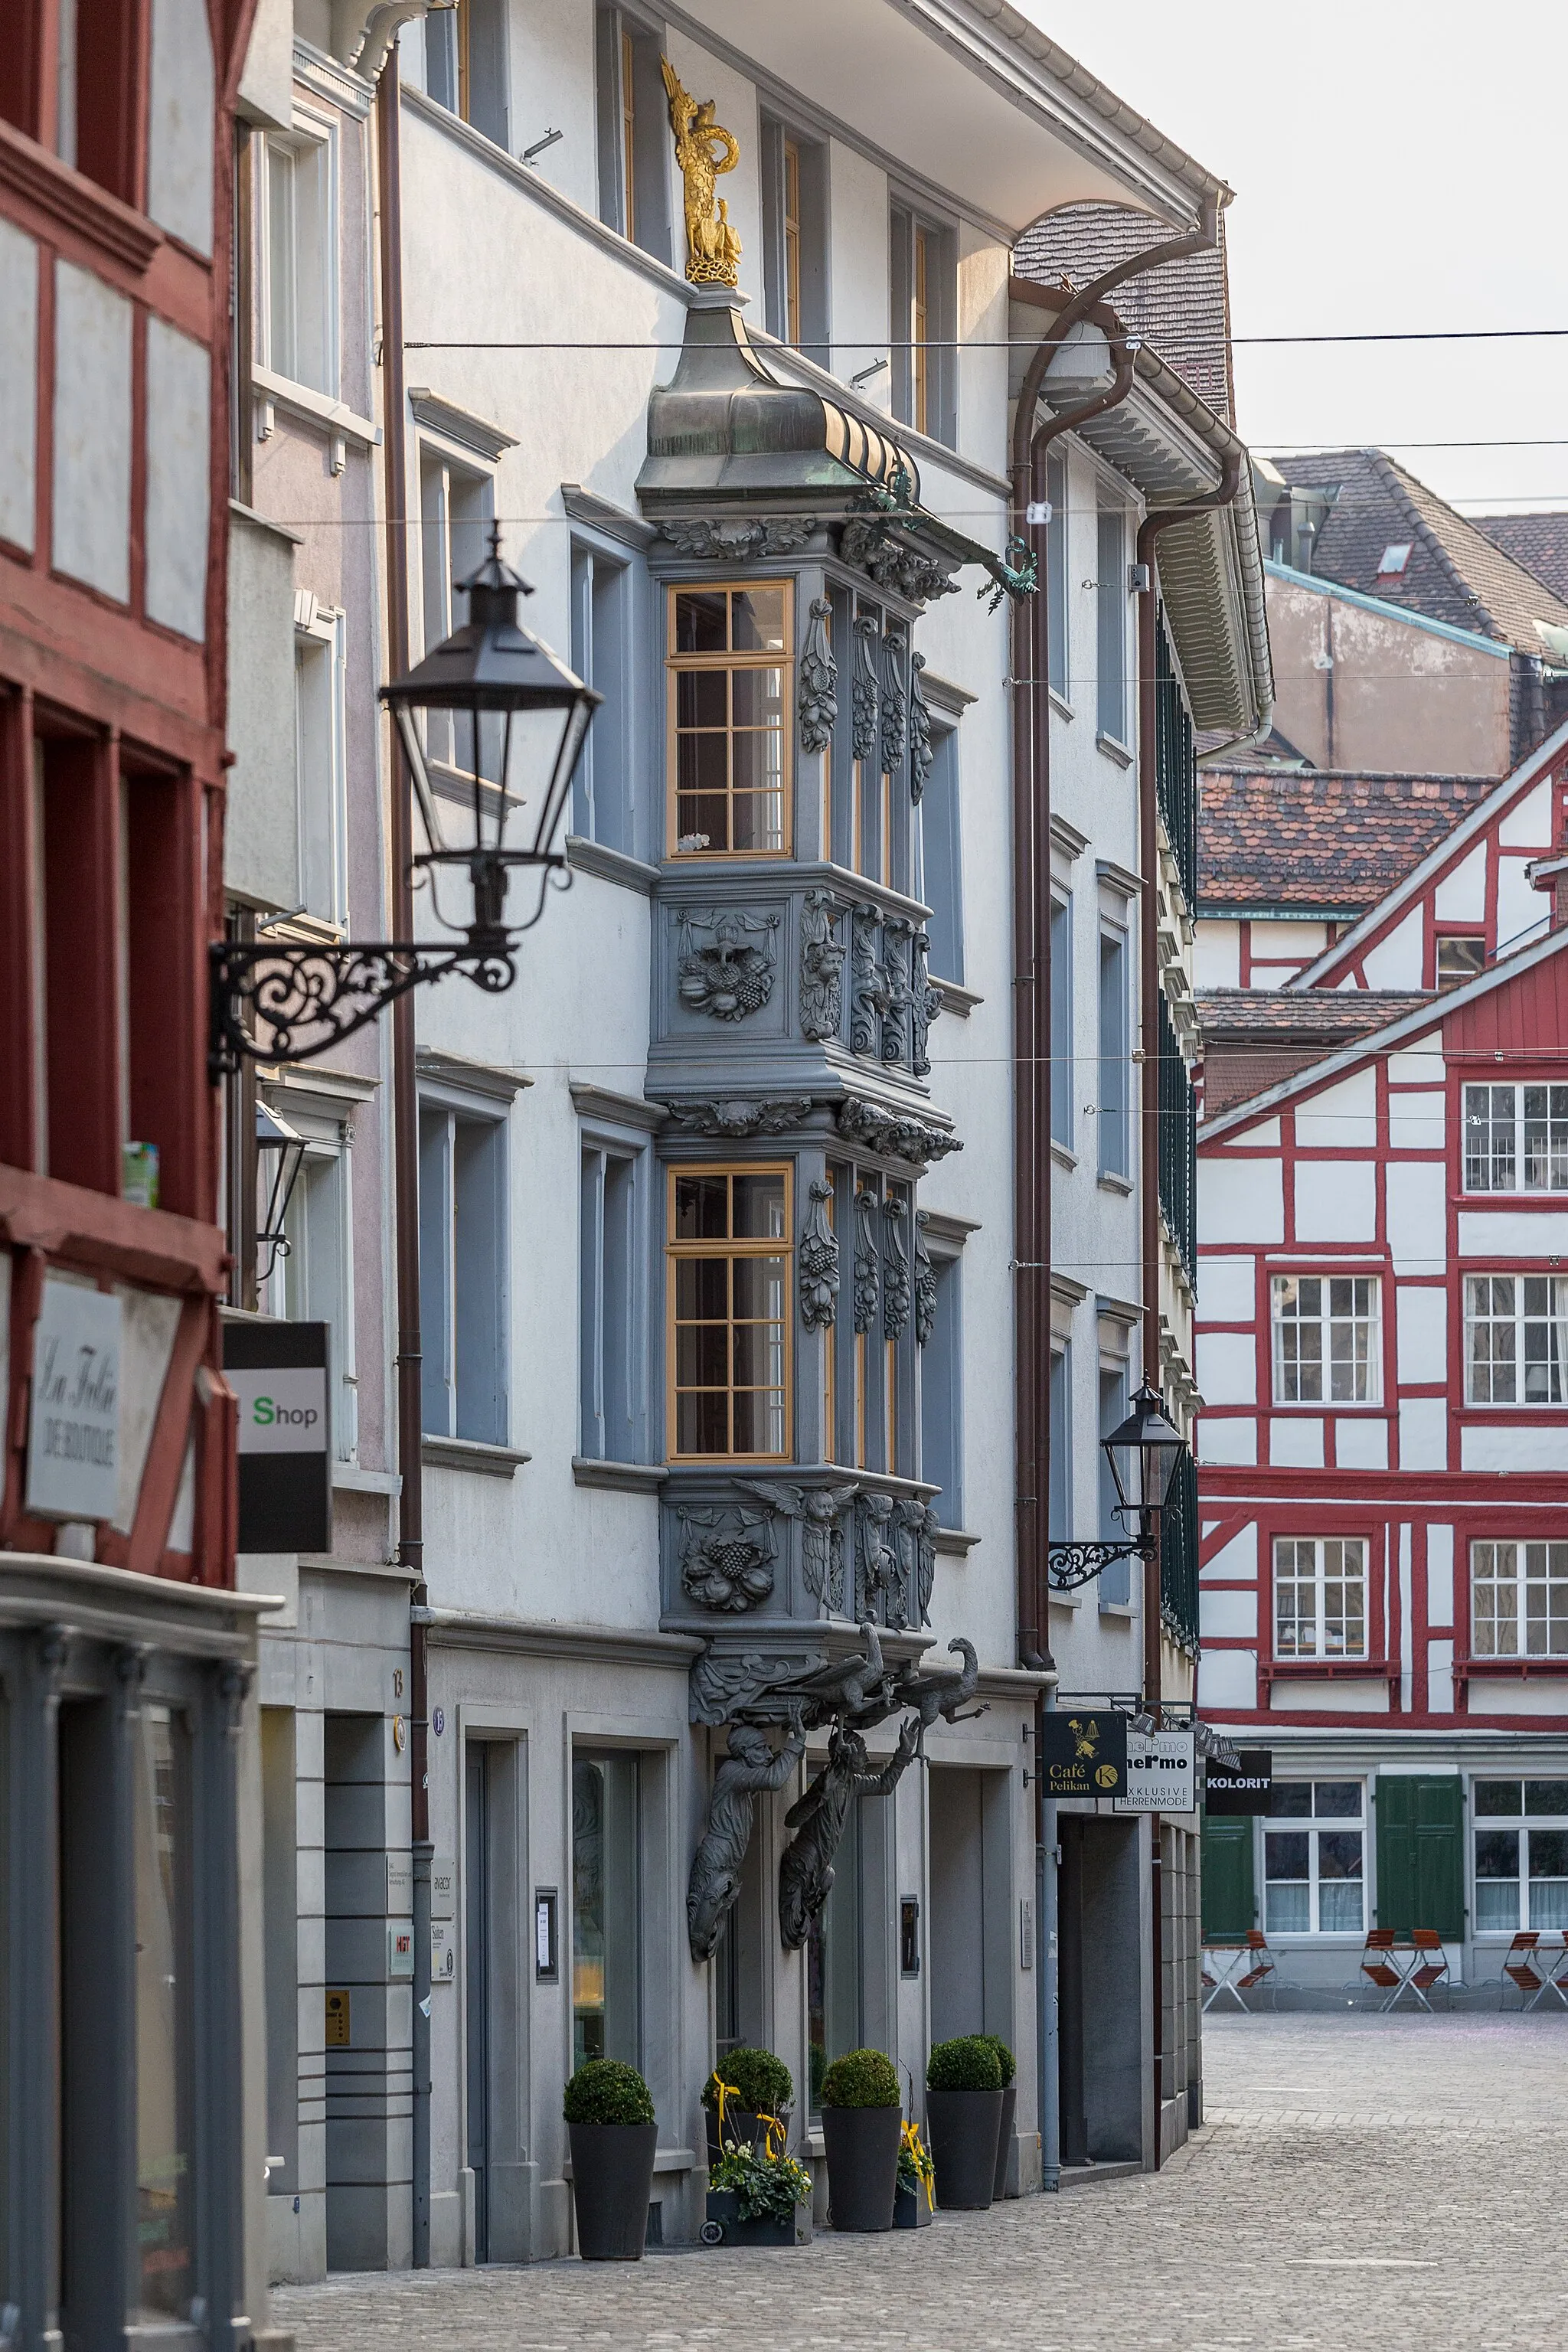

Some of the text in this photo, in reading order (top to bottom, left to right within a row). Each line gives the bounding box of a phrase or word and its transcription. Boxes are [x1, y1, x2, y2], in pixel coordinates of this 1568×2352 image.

[252, 1396, 318, 1430] Shop
[393, 1668, 403, 1698] 13
[1050, 1763, 1085, 1778] Café
[1050, 1781, 1089, 1791] Pelikan
[1207, 1777, 1271, 1788] KOLORIT
[1128, 1787, 1187, 1796] XKLUSIVE
[1120, 1797, 1187, 1805] HERRENMODE
